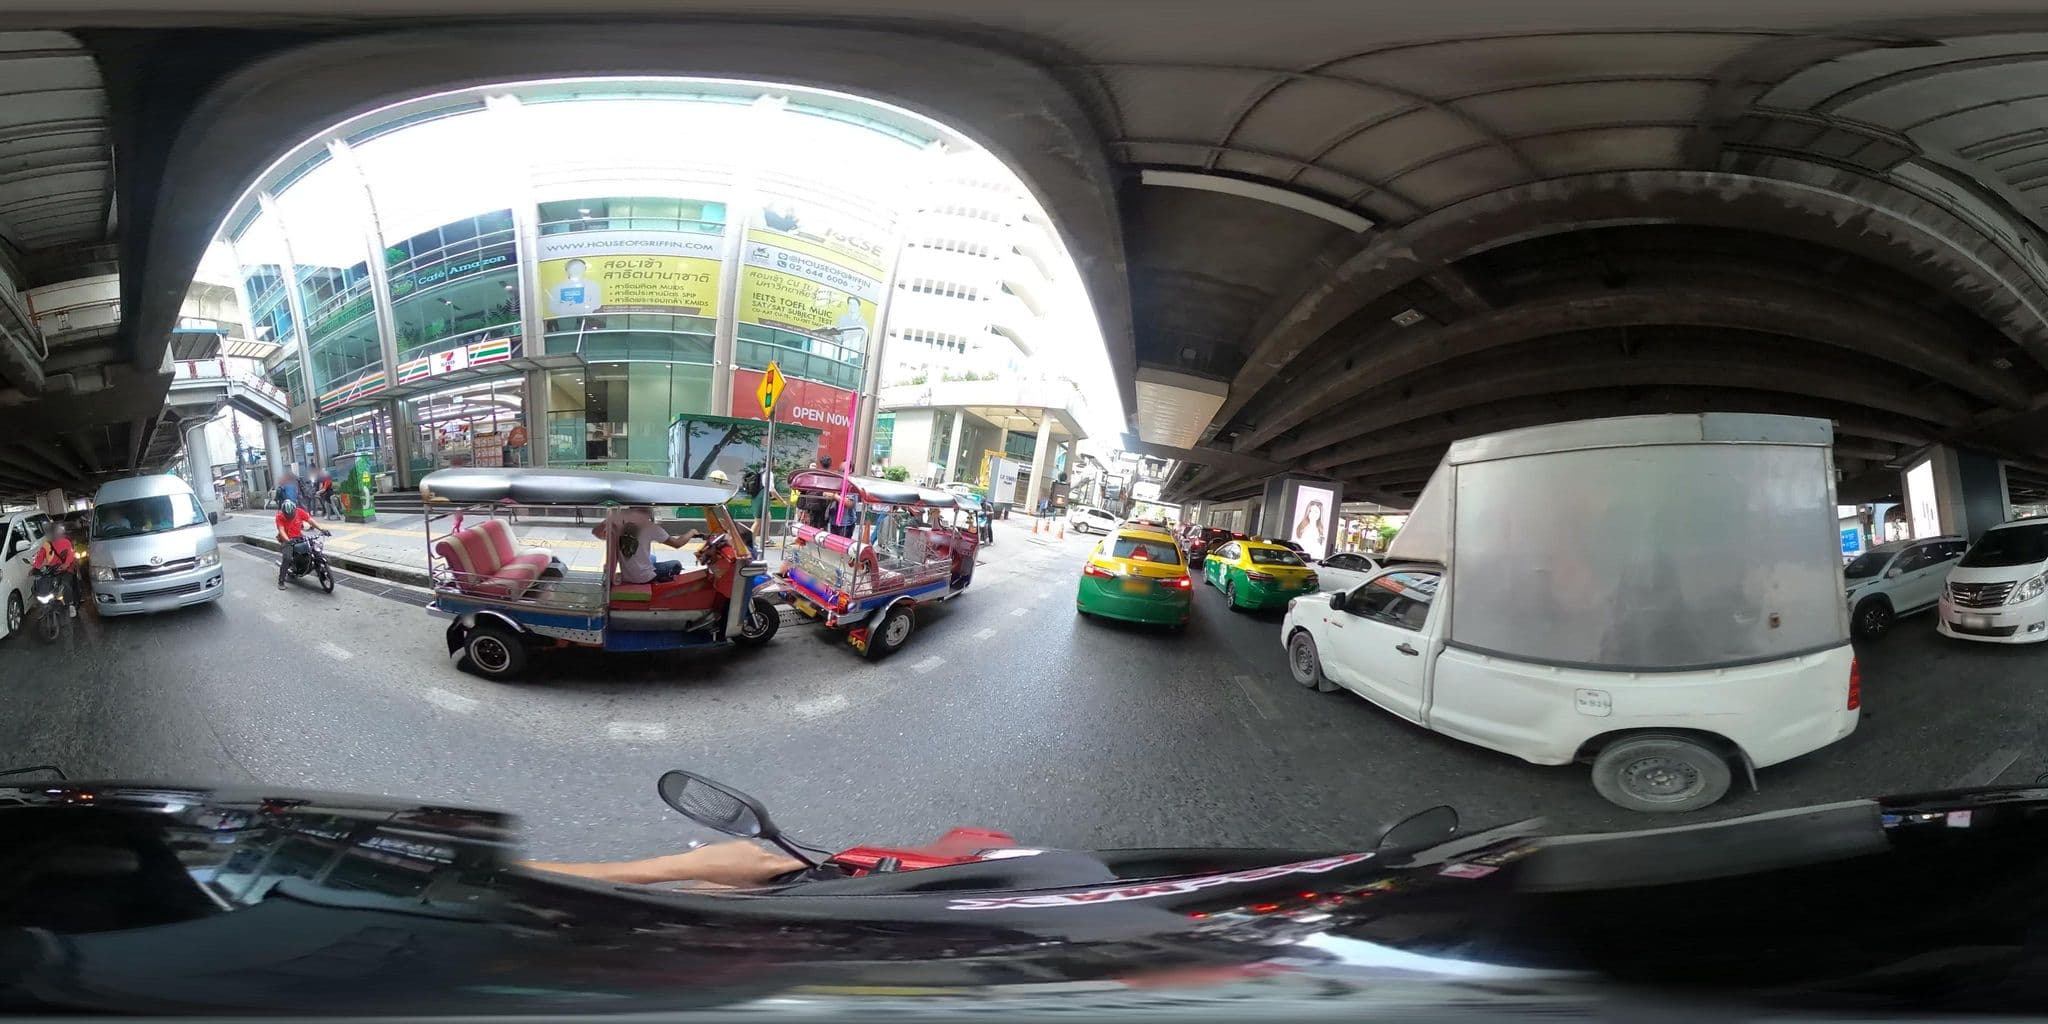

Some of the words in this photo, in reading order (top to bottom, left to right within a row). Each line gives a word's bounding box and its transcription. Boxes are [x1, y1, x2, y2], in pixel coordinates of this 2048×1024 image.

[546, 240, 713, 252] WWW.HOUSEOFGRIFFIN.COM
[418, 270, 445, 285] Café
[448, 255, 507, 275] Amazon
[789, 263, 801, 271] 02
[805, 268, 823, 278] 644
[827, 274, 848, 286] 6006
[752, 292, 776, 303] IELTS
[780, 298, 806, 310] TOEFL
[810, 306, 832, 318] MUIC
[788, 307, 816, 320] SUBJECT
[818, 315, 832, 325] TEST
[793, 406, 824, 422] OPEN
[826, 413, 850, 427] NOW
